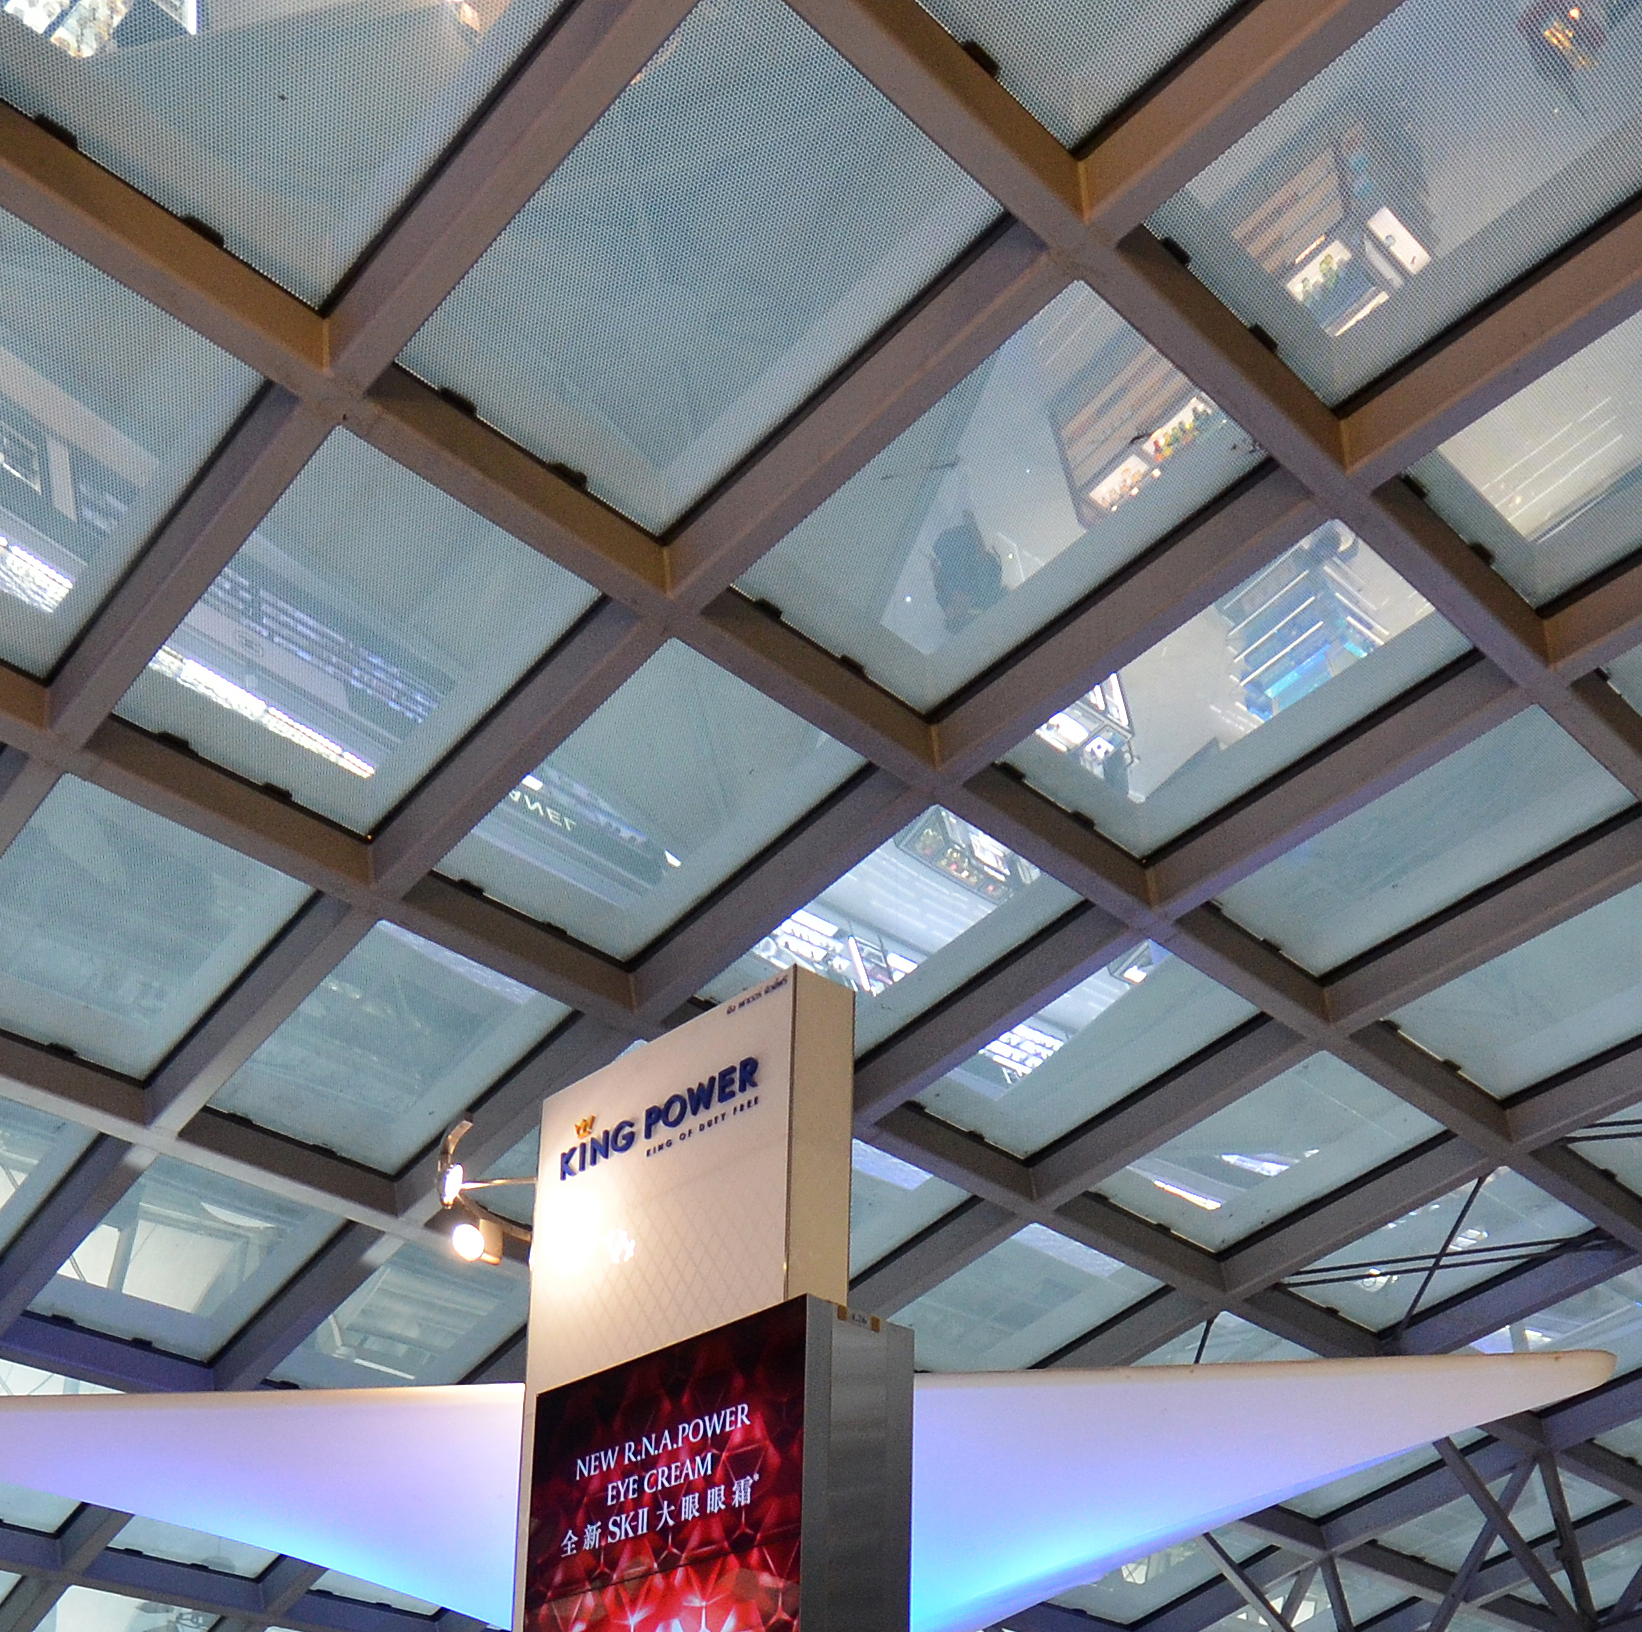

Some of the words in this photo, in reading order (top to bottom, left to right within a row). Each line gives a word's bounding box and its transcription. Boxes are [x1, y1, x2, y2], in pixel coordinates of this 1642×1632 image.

[560, 1120, 635, 1180] KING
[644, 1057, 759, 1139] POWER
[646, 1139, 673, 1157] KING
[679, 1129, 693, 1141] OF
[699, 1112, 727, 1132] DUTY
[733, 1096, 759, 1115] FREE
[576, 1446, 619, 1481] NEW
[624, 1403, 751, 1464] R.N.A.POWER
[607, 1475, 638, 1506] EYE
[644, 1452, 713, 1491] CREAM
[561, 1521, 602, 1558] 全新
